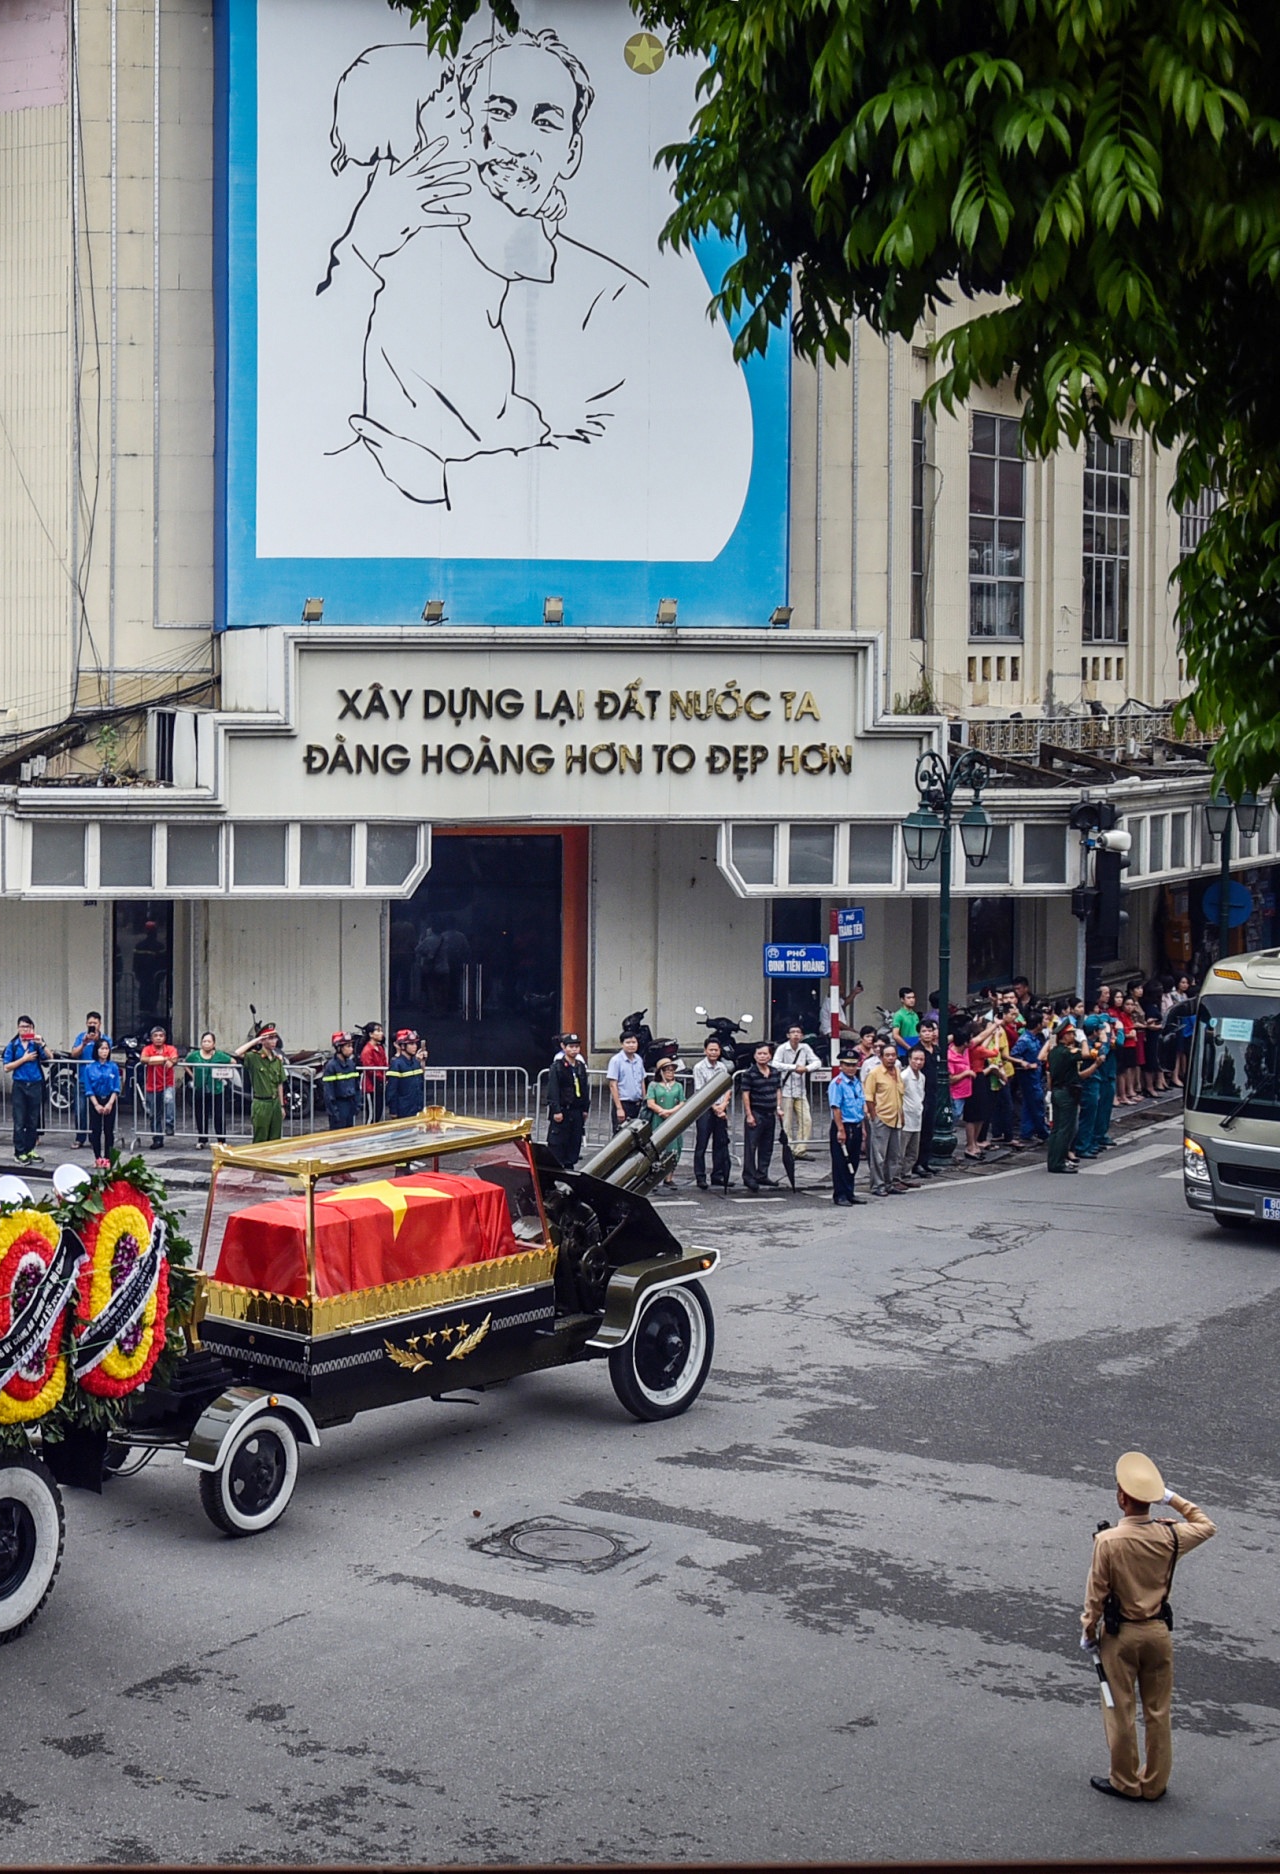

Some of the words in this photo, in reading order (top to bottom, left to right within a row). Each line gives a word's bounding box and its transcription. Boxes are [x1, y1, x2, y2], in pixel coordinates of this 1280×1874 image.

[338, 682, 413, 720] XÂY
[423, 687, 525, 726] DỰNG
[535, 689, 585, 726] LẠI
[594, 677, 662, 720] ĐẤT
[670, 680, 772, 721] NƯỚC
[780, 690, 821, 721] TA
[303, 733, 411, 775] ĐÀNG
[422, 735, 555, 775] HOÀNG
[565, 741, 643, 775] HƠN
[652, 743, 696, 775] TO
[705, 743, 769, 782] ĐẸP
[778, 741, 853, 775] HƠN
[768, 960, 785, 972] ĐINH
[802, 958, 825, 973] HOÀNG
[786, 947, 807, 957] PHỐ
